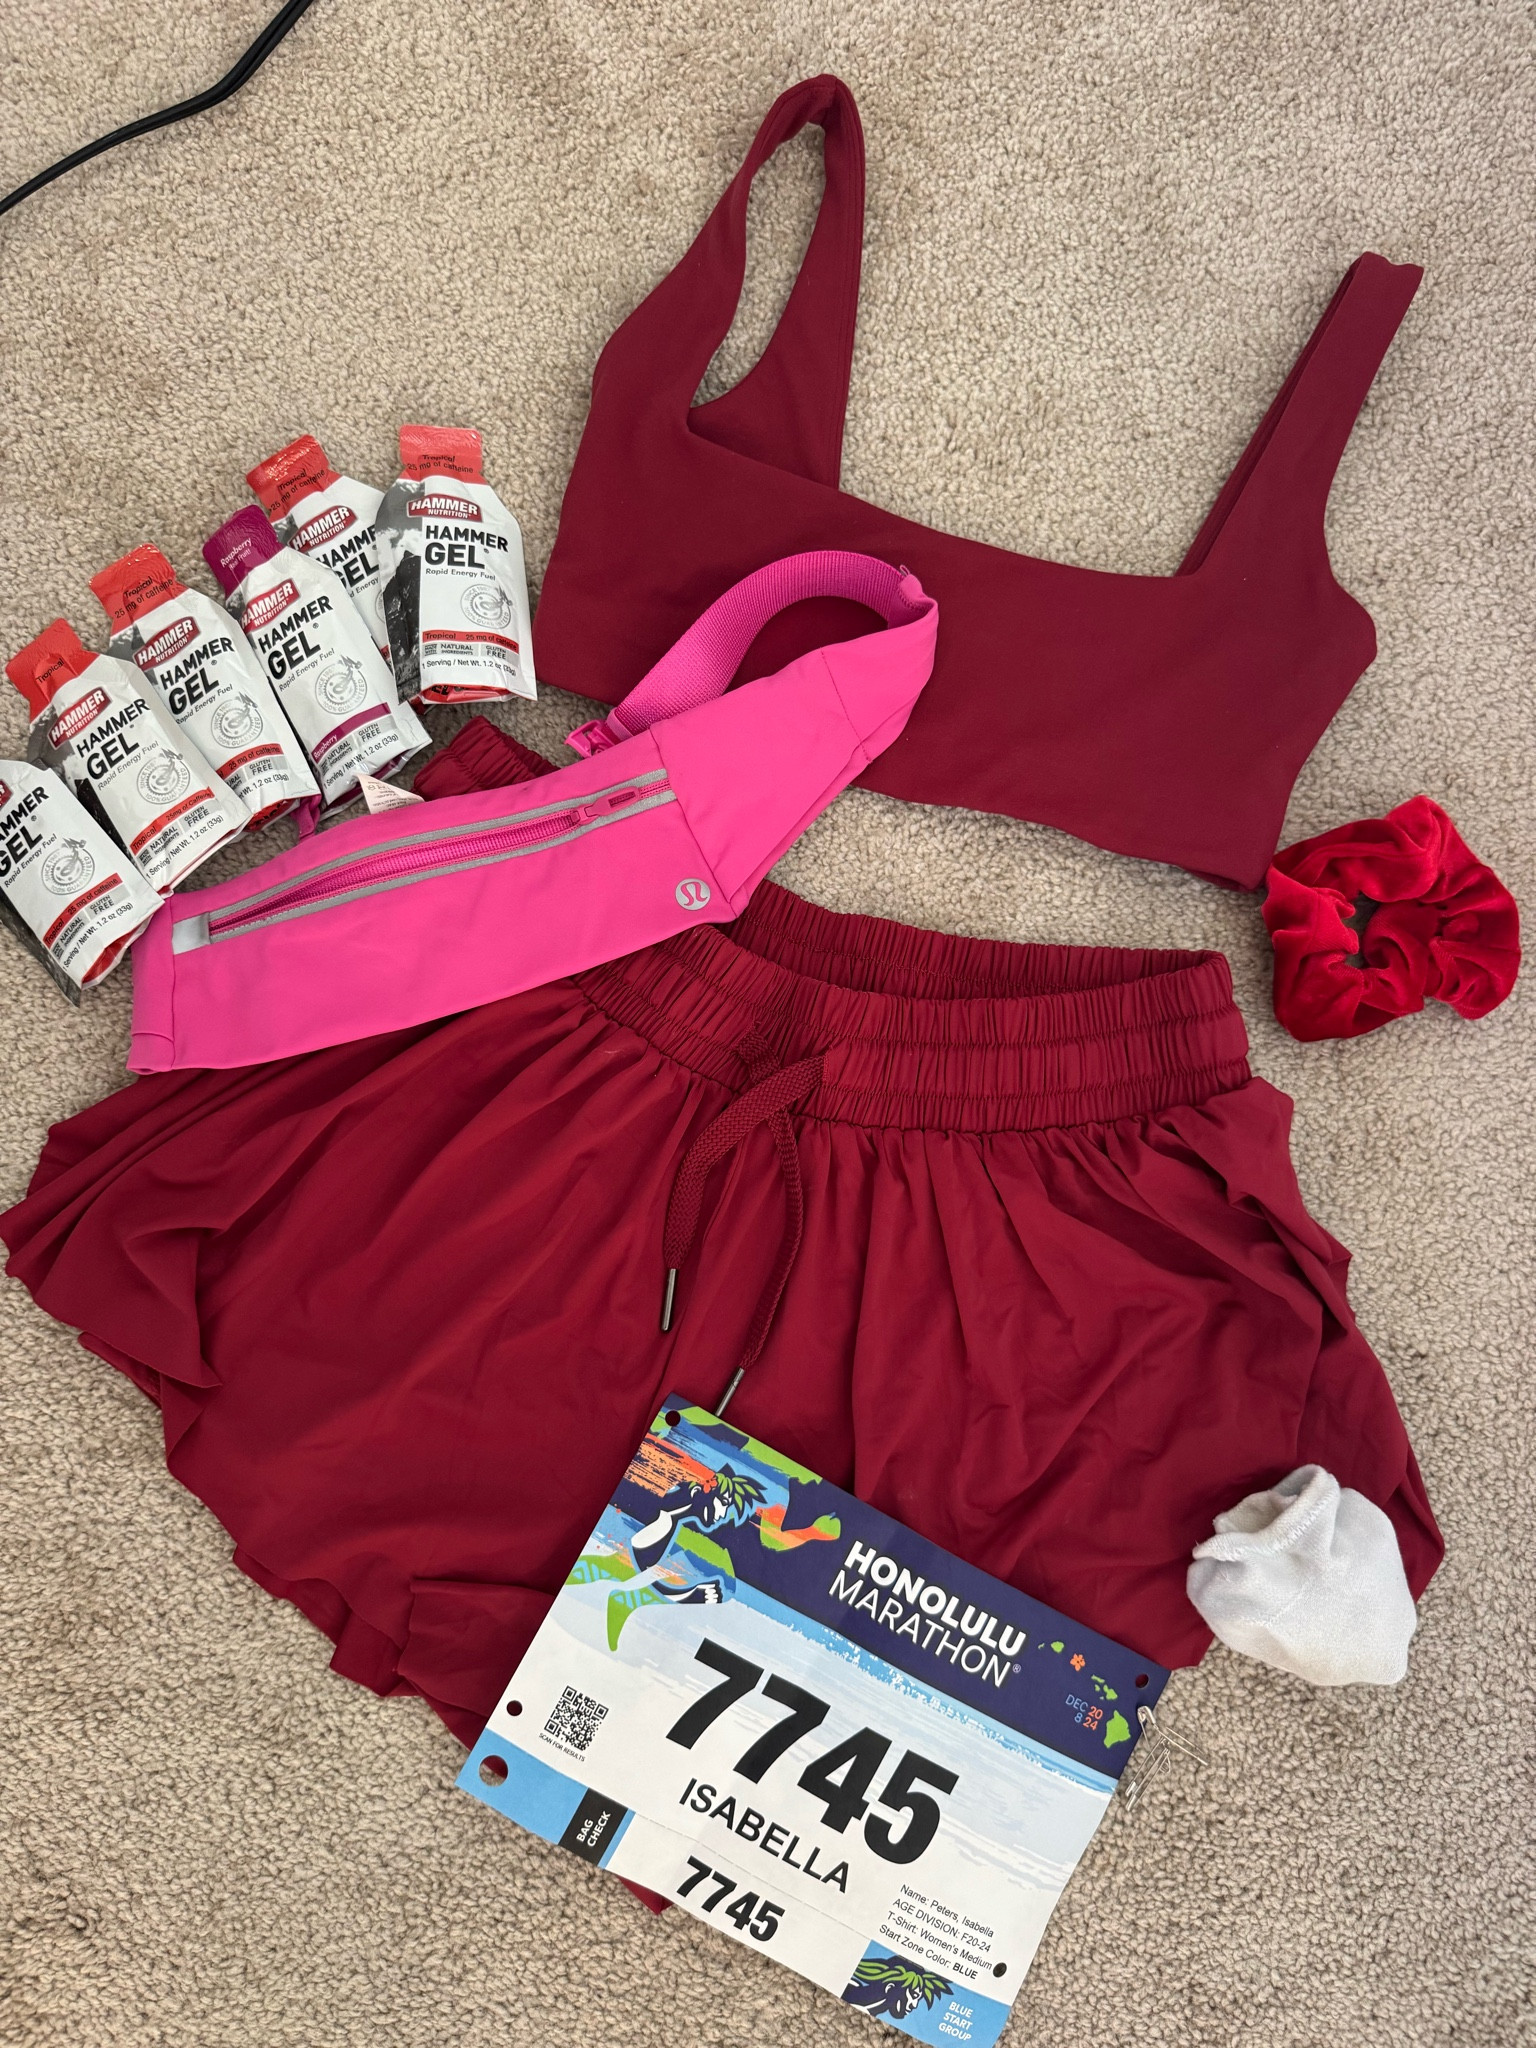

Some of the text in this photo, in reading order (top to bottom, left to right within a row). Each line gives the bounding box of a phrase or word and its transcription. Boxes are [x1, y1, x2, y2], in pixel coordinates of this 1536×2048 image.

[407, 463, 417, 471] 25
[420, 461, 431, 470] mg
[278, 468, 307, 491] Tropical
[281, 492, 291, 503] mg
[291, 484, 298, 494] of
[411, 497, 478, 515] HAMMER
[428, 509, 468, 519] NUTRITION
[292, 507, 350, 551] HAMMER
[309, 522, 345, 547] NUTRITION
[425, 525, 508, 552] HAMMER
[220, 537, 252, 568] Raspberry
[355, 577, 379, 594] Energy
[425, 568, 495, 581] Rapid Energy Fuel
[114, 578, 174, 619] 25 mg of caffeine
[123, 576, 153, 599] Tropical
[241, 582, 293, 629] HAMMER
[253, 600, 287, 627] NUTRITION
[258, 595, 333, 653] HAMMER
[137, 619, 194, 666] HAMMER
[155, 636, 188, 663] NUTRITION
[440, 643, 473, 651] NATURAL
[486, 645, 506, 653] GLUTEN
[159, 637, 235, 690] HAMMER
[427, 659, 452, 668] Serving
[487, 651, 506, 660] FREE
[37, 657, 65, 684] Tropical
[278, 648, 335, 692] Rapid Energy Fuel
[51, 690, 105, 742] HAMMER
[176, 710, 194, 724] Rapid
[194, 694, 216, 713] Energy
[217, 683, 233, 697] Fuel
[65, 709, 98, 738] NUTRITION
[76, 698, 150, 758] HAMMER
[358, 723, 379, 736] GLUTEN
[362, 728, 381, 742] FREE
[314, 734, 338, 760] Raspberry
[326, 733, 399, 785] Serving Net Wt. 1.2 oz (33g)
[327, 741, 351, 763] NATURAL
[98, 740, 159, 791] Rapid Energy Fuel
[228, 761, 237, 770] 25
[237, 755, 248, 765] mg
[248, 750, 255, 759] of
[249, 759, 271, 770] GLUTEN
[252, 763, 273, 775] FREE
[252, 779, 264, 789] 1.2
[182, 803, 188, 811] of
[184, 806, 204, 822] GLUTEN
[187, 809, 210, 827] FREE
[132, 825, 157, 850] Tropical
[149, 815, 224, 876] Serving Net Wt. 1.2 oz (33g)
[150, 826, 178, 851] NATURAL
[4, 833, 57, 888] Rapid Energy Fuel
[46, 918, 65, 944] Tropical
[68, 905, 77, 915] 25
[76, 898, 88, 907] mg
[94, 878, 119, 896] caffeine
[90, 895, 111, 910] GLUTEN
[94, 899, 114, 915] FREE
[60, 917, 83, 942] NATURAL
[63, 947, 80, 968] Serving
[78, 933, 89, 945] Net
[86, 926, 98, 935] Wt.
[96, 917, 109, 927] 1.2
[107, 913, 117, 921] oz
[115, 902, 134, 917] (33g)
[844, 1540, 1027, 1657] HONOLULU
[1065, 1694, 1103, 1719] DEC 20
[1074, 1713, 1098, 1731] 8 24
[538, 1732, 585, 1762] SCAN FOR RESULTS
[666, 1637, 960, 1865] 7745
[576, 1818, 594, 1843] BAG
[586, 1810, 611, 1848] CHECK
[679, 1777, 850, 1894] ISABELLA
[676, 1854, 786, 1942] 7745
[900, 1884, 994, 1938] Name: Peters, Isabella
[892, 1898, 991, 1953] AGE DIVISION: F20-24
[879, 1924, 979, 1980] Start Zone Color: BLUE
[886, 1910, 993, 1971] T-Shirt: Women's Medium
[943, 2012, 973, 2031] START
[949, 2001, 974, 2018] BLUE
[938, 2022, 972, 2042] GROUP
